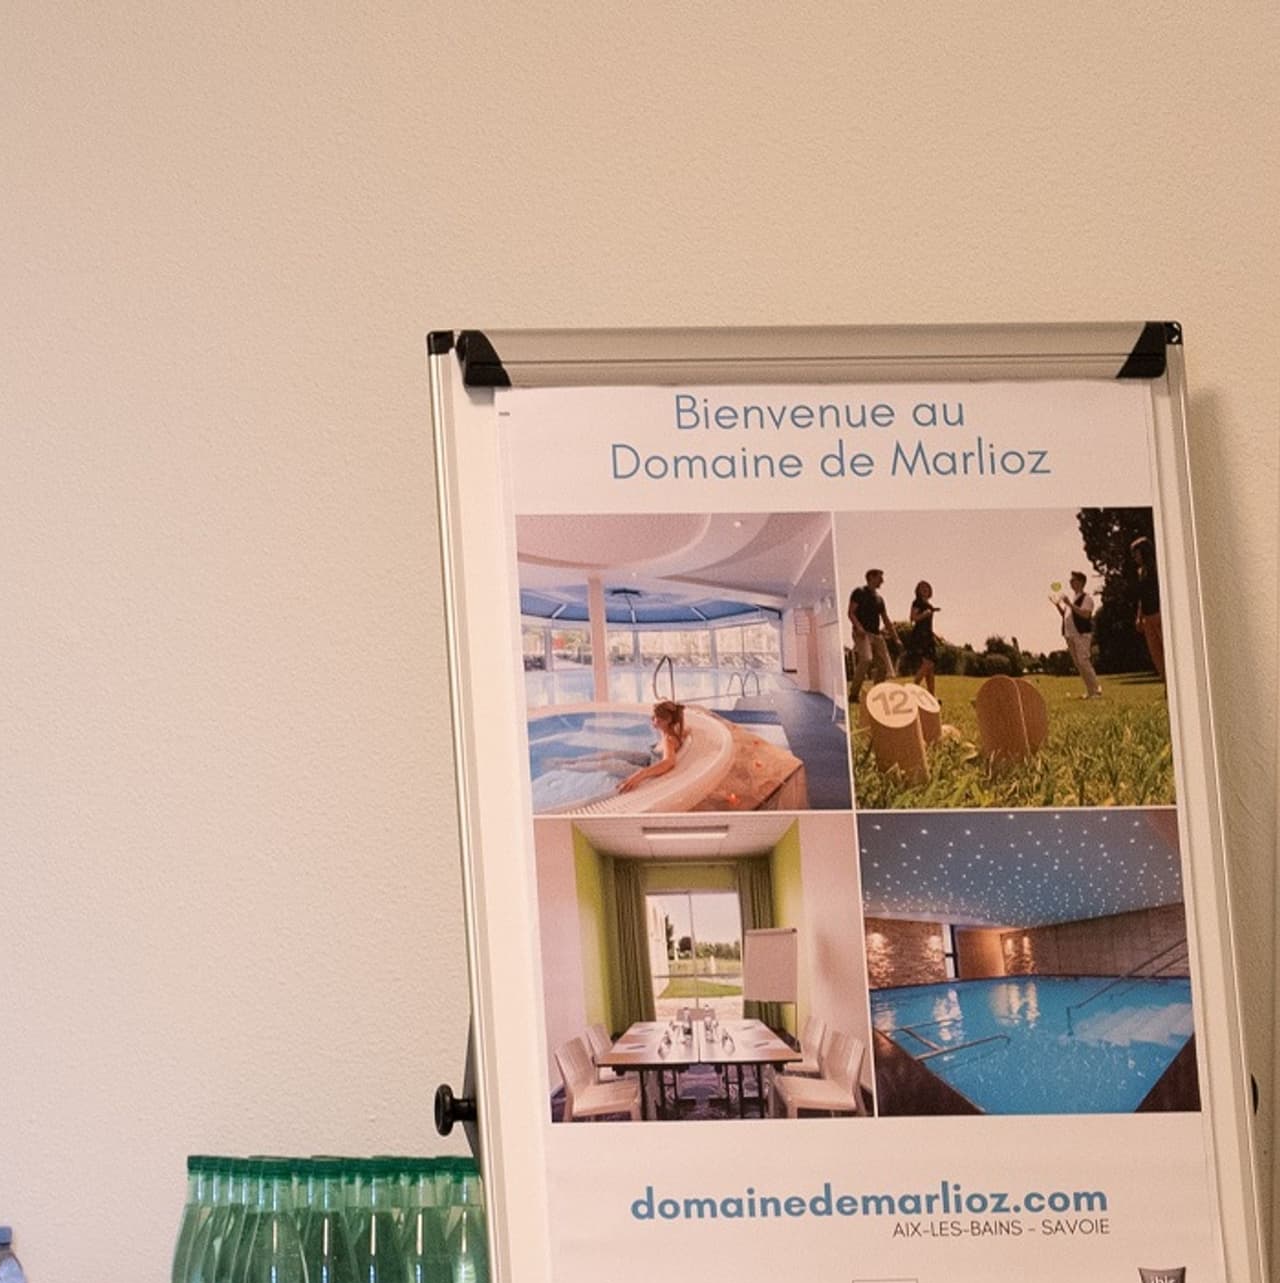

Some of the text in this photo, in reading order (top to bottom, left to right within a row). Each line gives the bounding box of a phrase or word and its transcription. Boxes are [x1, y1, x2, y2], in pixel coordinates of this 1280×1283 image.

[675, 394, 964, 430] Bienvenue au
[612, 436, 1052, 480] Domaine de Marlioz
[872, 690, 913, 716] 12
[631, 1181, 1108, 1220] domainedemarlioz.com
[892, 1219, 1023, 1239] AIX-LES-BAINS
[1041, 1218, 1110, 1236] SAVOIE
